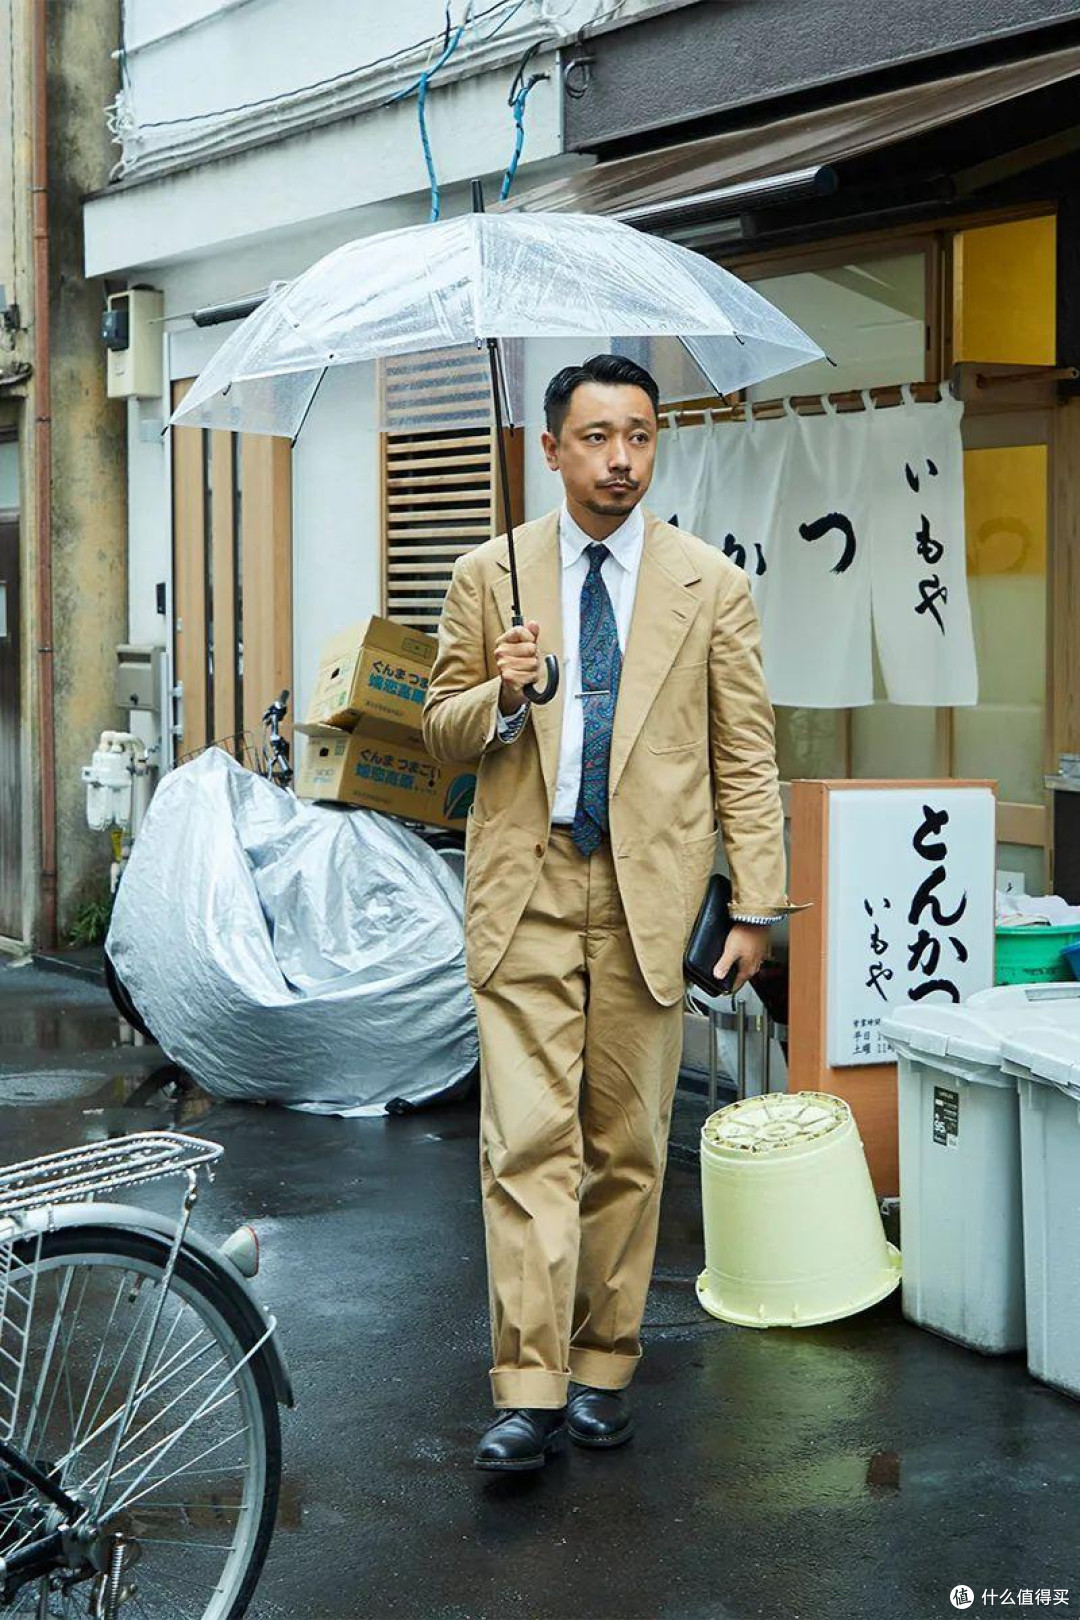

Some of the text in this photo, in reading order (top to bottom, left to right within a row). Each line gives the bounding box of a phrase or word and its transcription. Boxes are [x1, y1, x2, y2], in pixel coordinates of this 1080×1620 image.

[905, 458, 948, 636] いもや
[863, 896, 893, 1002] いもや
[907, 804, 968, 1004] とんかつ
